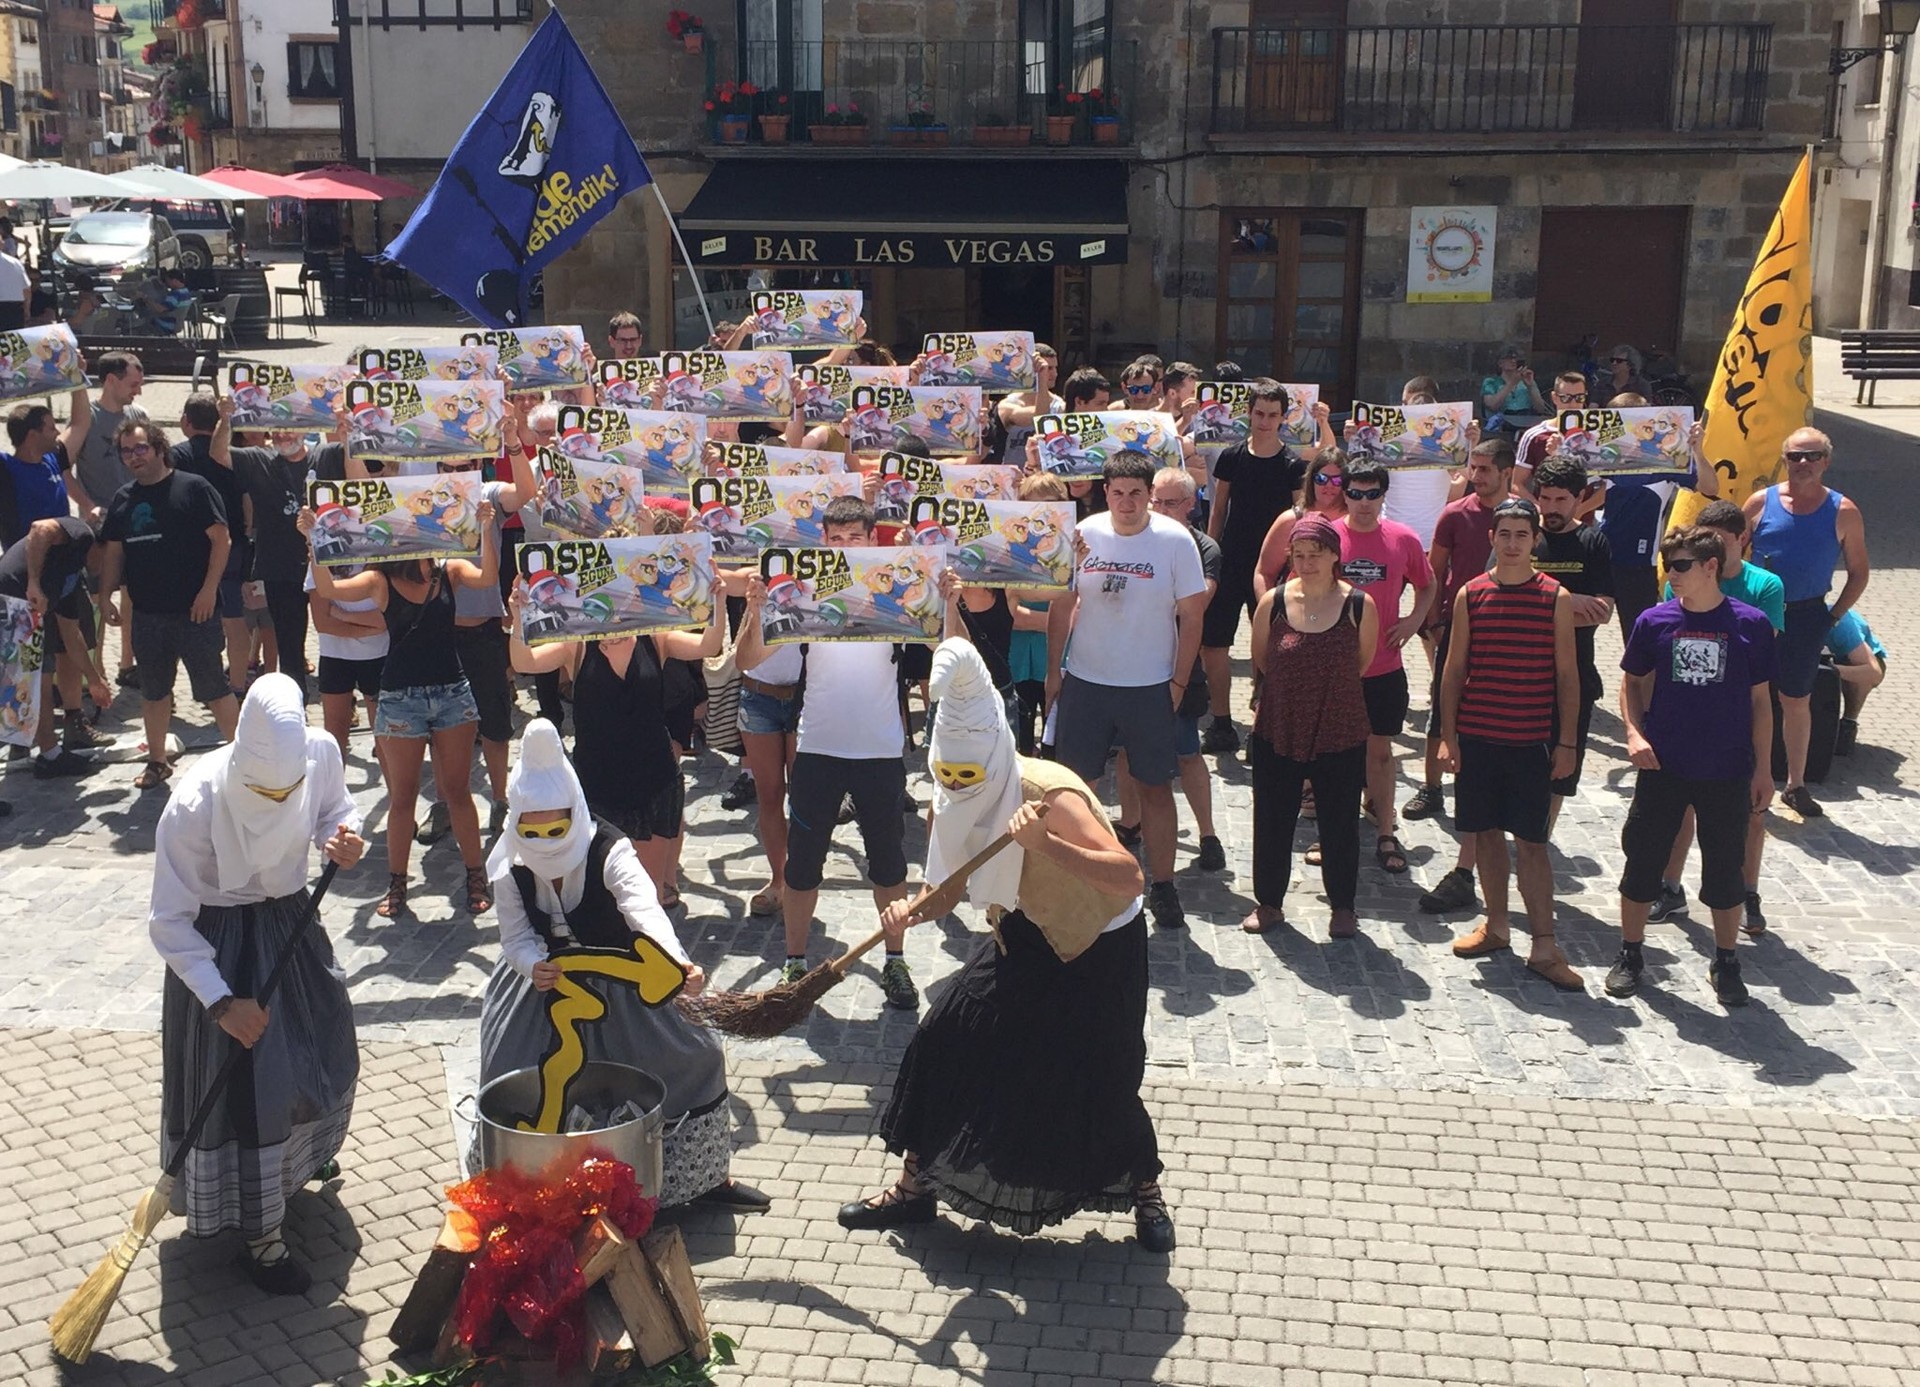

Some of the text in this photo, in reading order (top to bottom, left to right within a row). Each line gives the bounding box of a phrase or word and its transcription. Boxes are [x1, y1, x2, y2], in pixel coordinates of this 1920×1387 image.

[536, 171, 573, 217] de
[754, 236, 1055, 263] BAR LAS VEGAS
[752, 291, 806, 312] OSPA
[0, 332, 28, 357] SPA
[925, 334, 977, 354] OSPA
[229, 363, 295, 386] OSPA
[359, 349, 427, 374] OSPA
[600, 360, 660, 385] OSPA
[662, 352, 727, 378] OSPA
[345, 381, 422, 410] OSPA
[852, 387, 915, 411] OSPA
[557, 405, 630, 437] OSPA
[1037, 414, 1104, 435] OSPA
[1354, 402, 1406, 423] OSPA
[1560, 410, 1624, 433] OSPA
[538, 446, 576, 479] OSPA
[705, 442, 769, 467] OSPA
[880, 451, 943, 482] OSPA
[309, 480, 392, 508] OSPA
[692, 478, 773, 512] OSPA
[909, 496, 990, 526] OSPA
[517, 542, 613, 578] OSPA
[760, 548, 850, 581] OSPA
